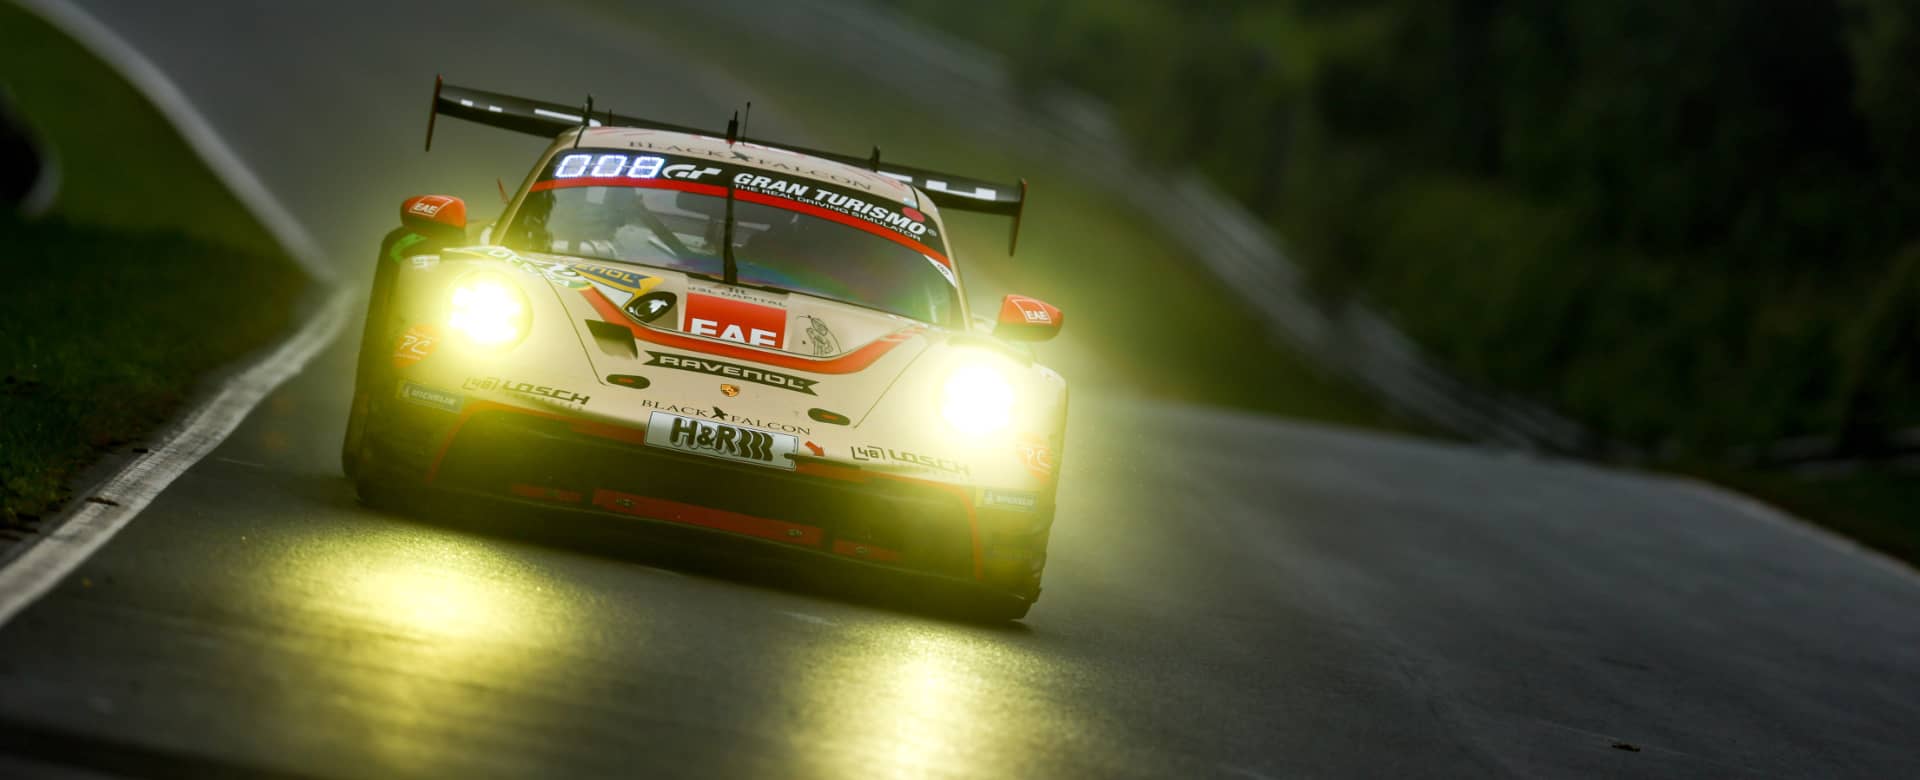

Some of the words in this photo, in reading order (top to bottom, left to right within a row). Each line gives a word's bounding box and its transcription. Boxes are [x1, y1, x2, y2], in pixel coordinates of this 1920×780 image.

[555, 153, 665, 179] 008
[629, 141, 724, 158] BLACK
[759, 158, 872, 191] FALCON
[733, 172, 809, 197] GRAN
[735, 183, 759, 193] THE
[762, 188, 794, 201] REAL
[797, 196, 849, 214] DRIVING
[851, 211, 921, 242] SIMULATOR
[659, 355, 805, 390] RAVENOL
[502, 380, 591, 406] LOSCH
[641, 399, 708, 418] BLACK
[731, 414, 812, 436] FALCON
[887, 448, 971, 477] LOSCH
